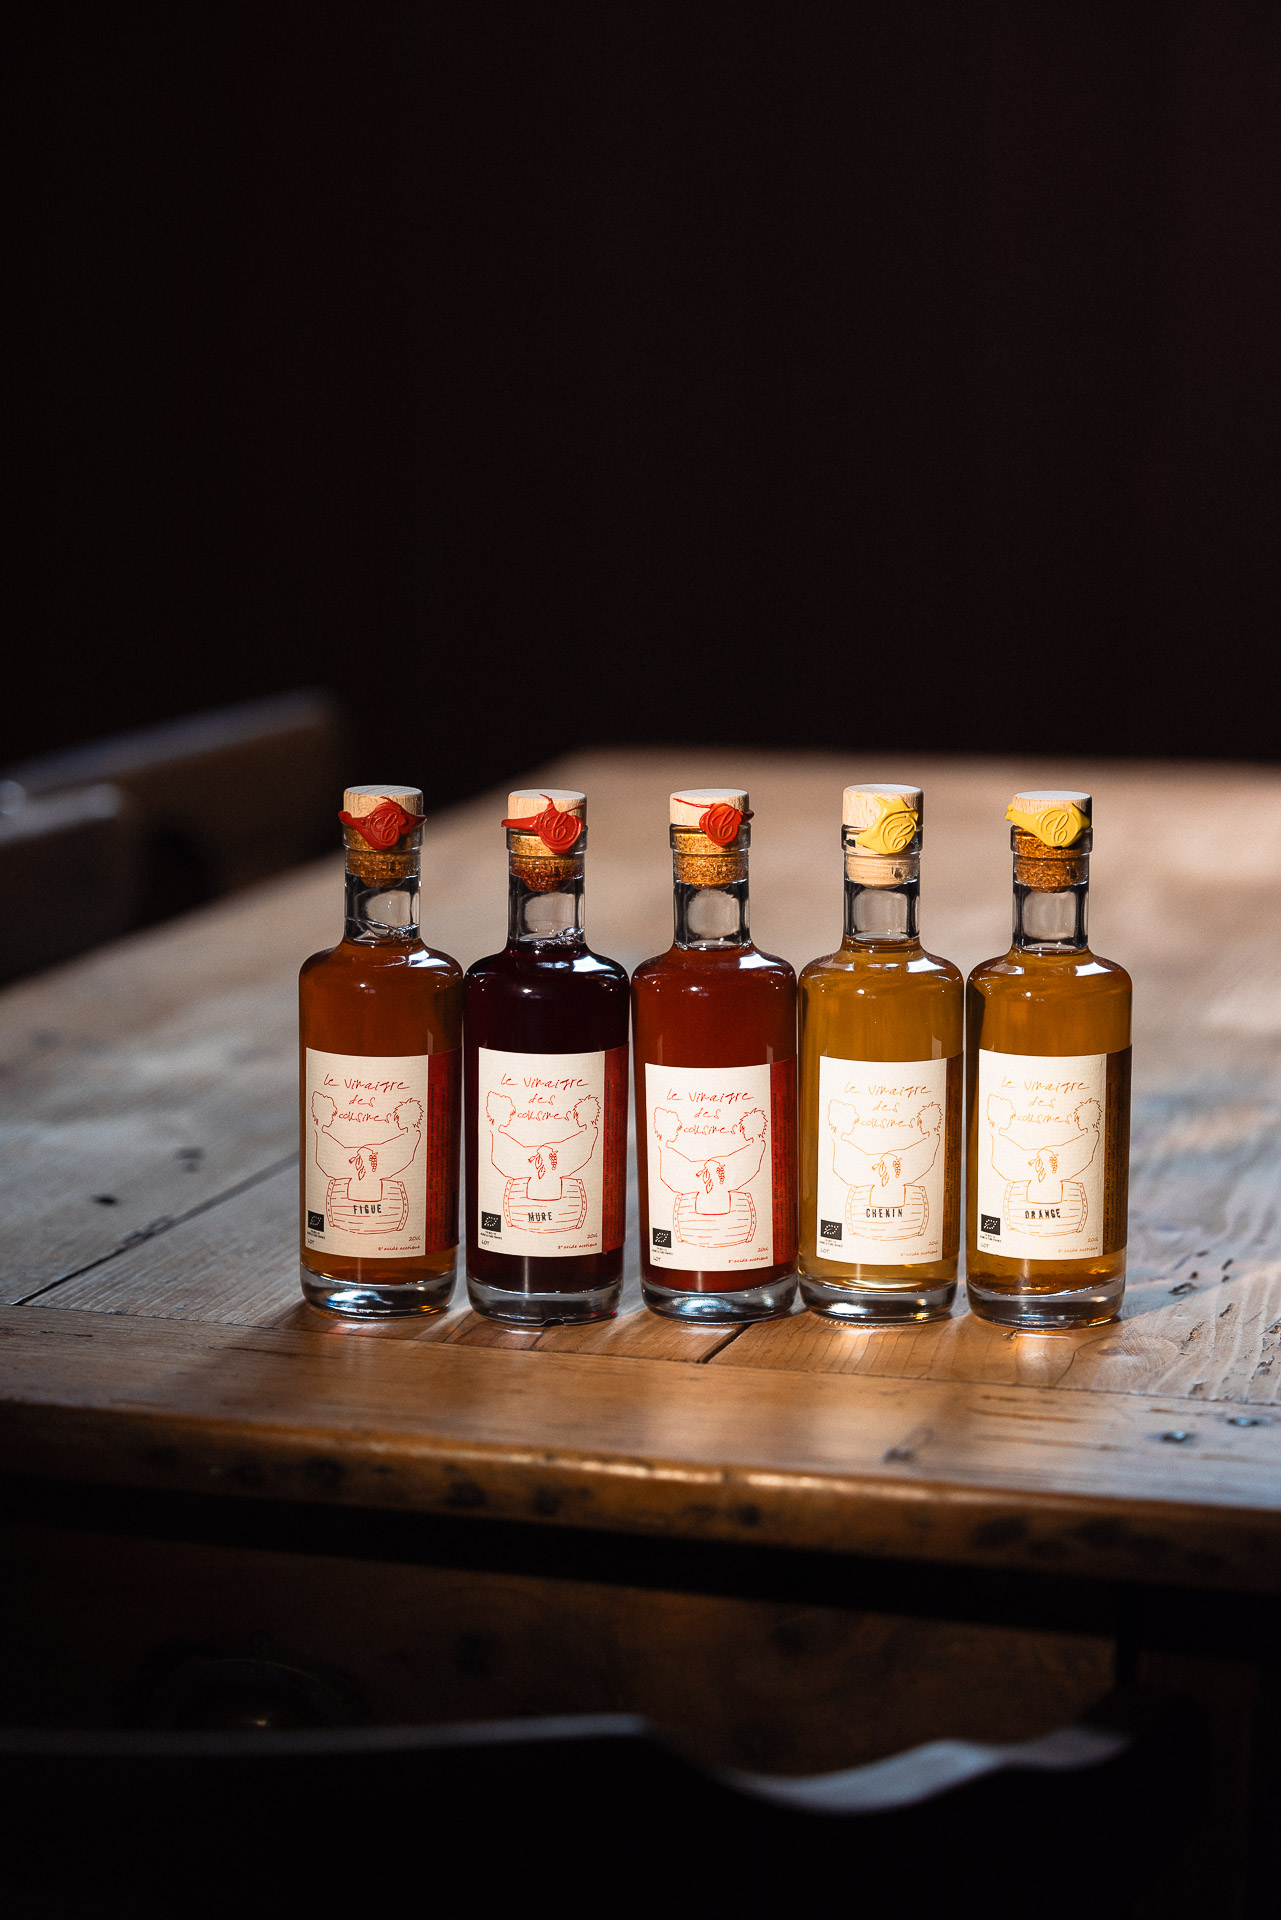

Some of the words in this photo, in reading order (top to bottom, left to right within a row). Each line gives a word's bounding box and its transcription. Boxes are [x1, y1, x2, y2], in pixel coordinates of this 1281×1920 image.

[349, 1096, 376, 1108] des
[529, 1094, 555, 1106] des
[1028, 1096, 1056, 1108] des
[872, 1101, 900, 1112] des
[694, 1108, 721, 1119] des
[353, 1204, 382, 1215] FIGUE
[866, 1208, 903, 1218] CHENIN
[1025, 1208, 1061, 1219] ORANGE
